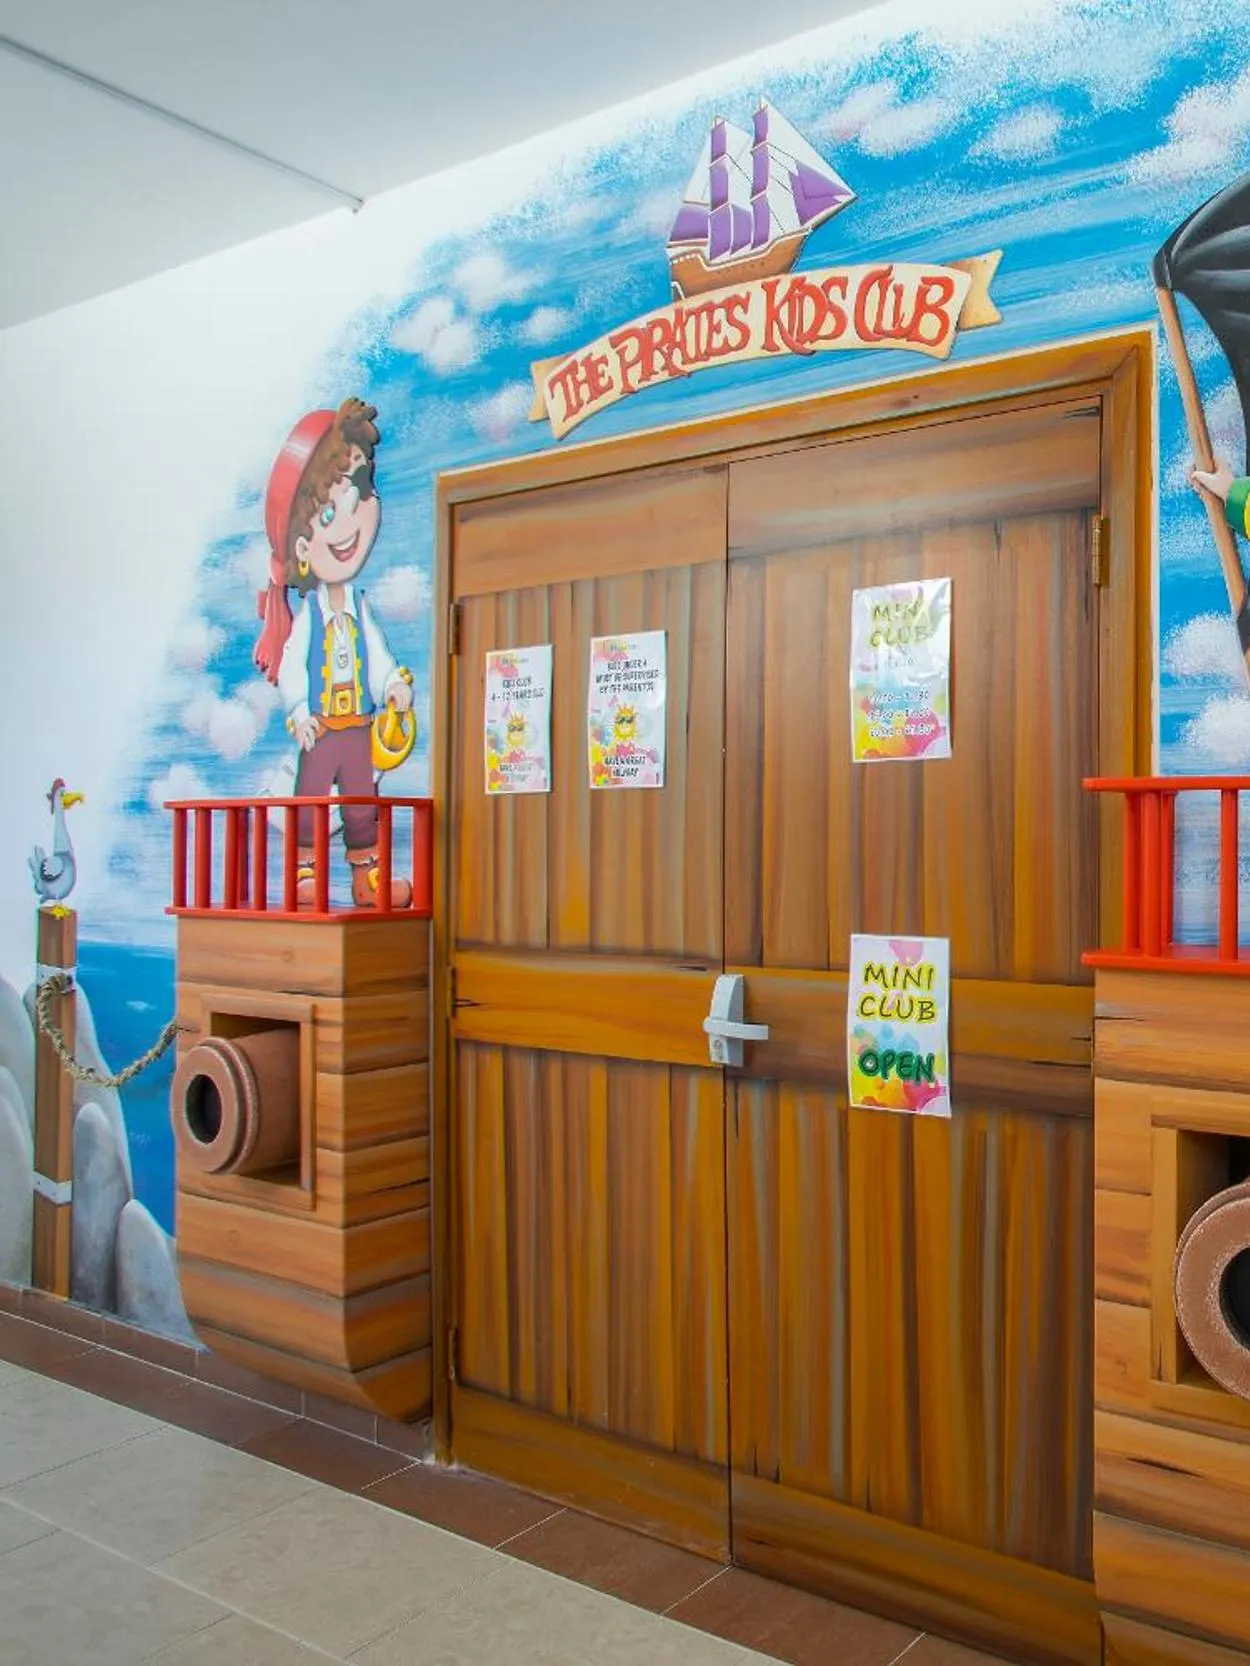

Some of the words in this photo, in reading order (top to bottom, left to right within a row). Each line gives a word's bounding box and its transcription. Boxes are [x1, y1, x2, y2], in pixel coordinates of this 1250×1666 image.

[548, 352, 613, 423] THE
[760, 276, 849, 356] KIDS
[854, 264, 955, 347] CLUB
[863, 963, 935, 990] MINI
[860, 995, 935, 1021] CLUB
[858, 1049, 936, 1086] OPEN
